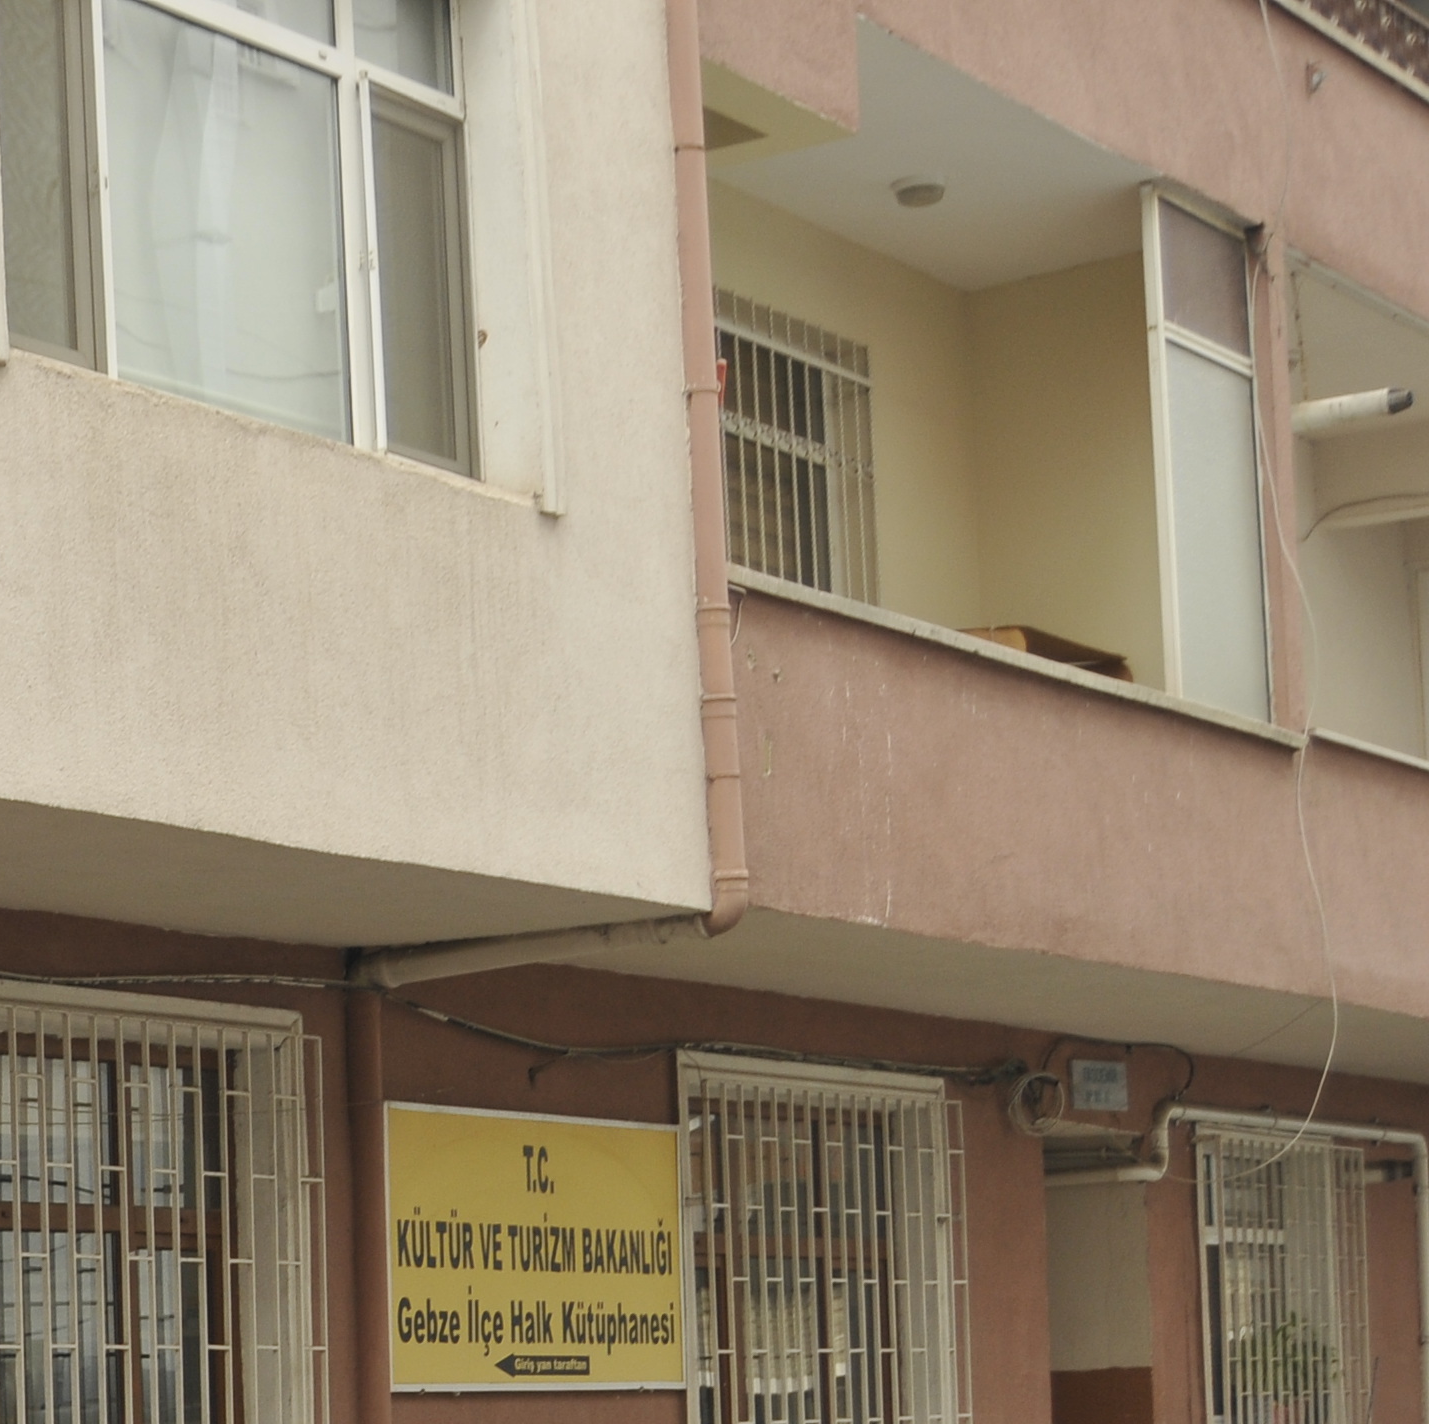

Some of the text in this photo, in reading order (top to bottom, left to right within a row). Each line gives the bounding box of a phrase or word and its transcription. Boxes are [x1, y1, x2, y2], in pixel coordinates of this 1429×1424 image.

[523, 1145, 554, 1194] T.C.
[398, 1207, 672, 1275] KÜLTÜR VE TURİZM BAKANLIĞI
[398, 1285, 675, 1356] Gebze İlçe Halk Kütüphanesi
